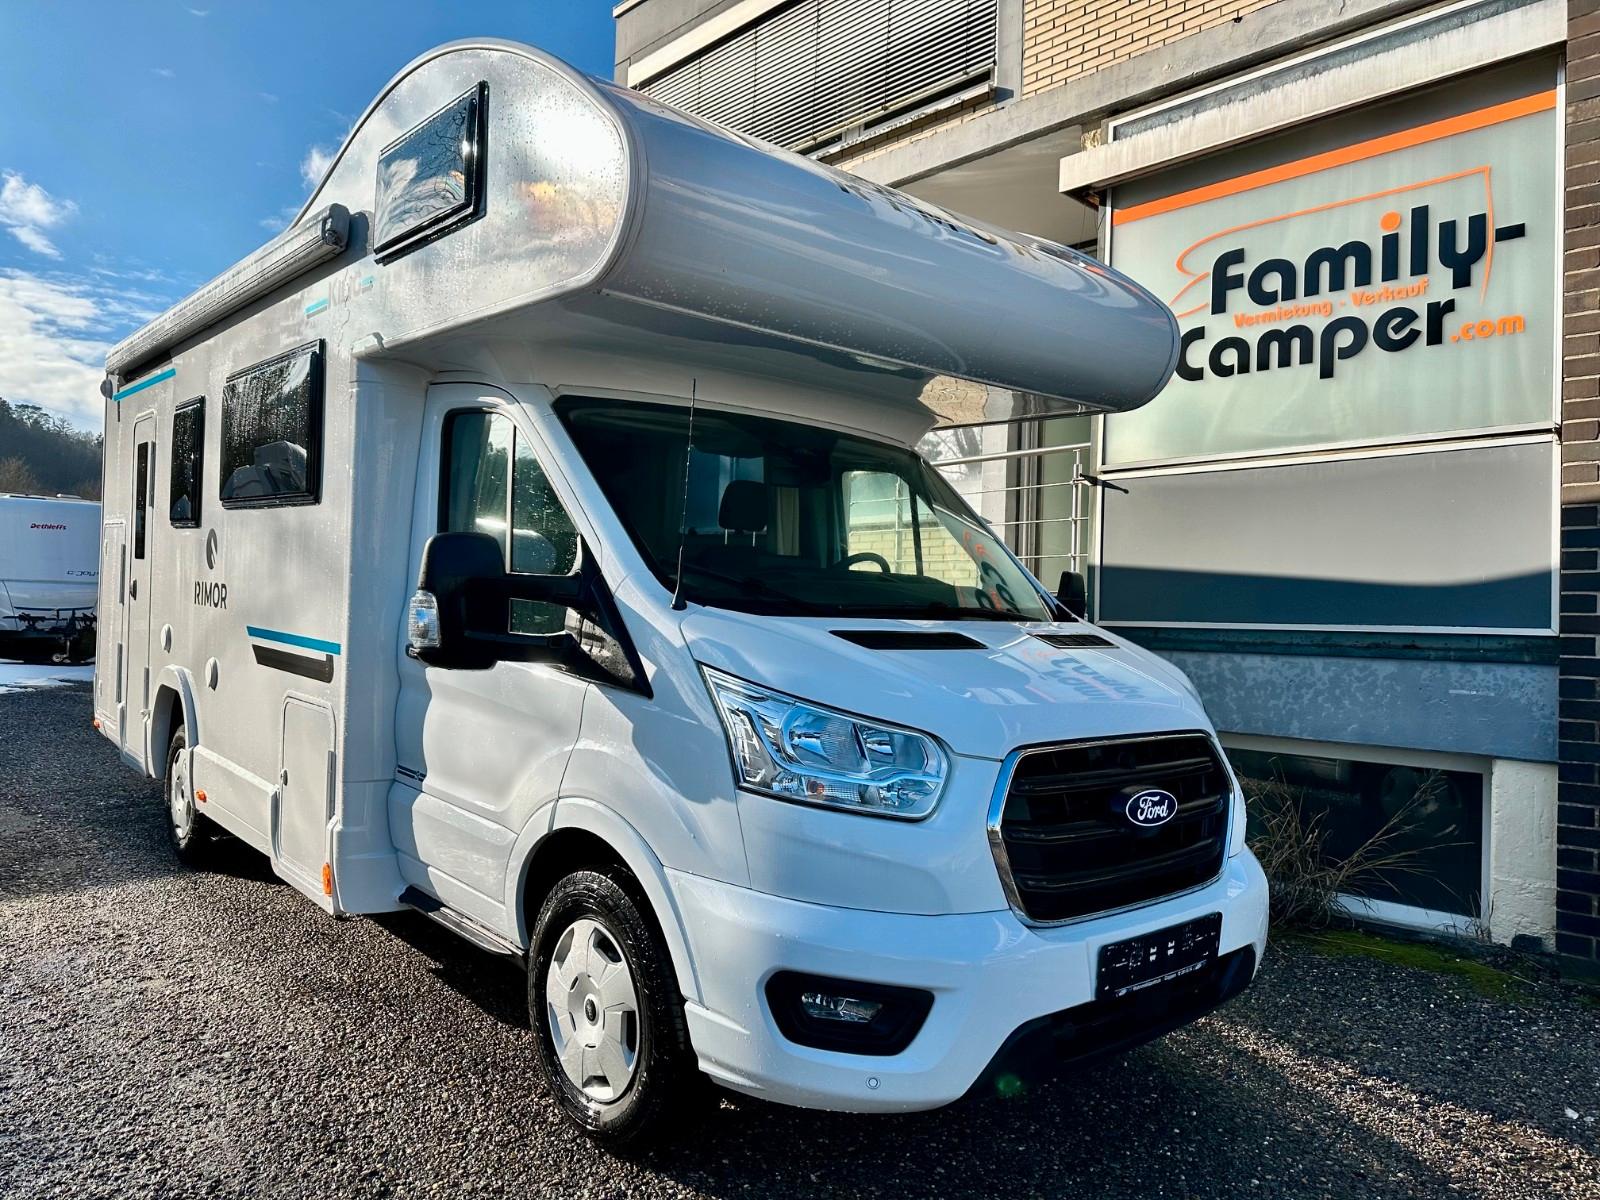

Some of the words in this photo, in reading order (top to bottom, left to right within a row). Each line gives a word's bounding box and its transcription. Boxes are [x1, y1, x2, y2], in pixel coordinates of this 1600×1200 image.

[1234, 301, 1332, 328] Vermietung
[1350, 278, 1429, 307] Verkauf
[30, 523, 67, 531] Dethleffs
[195, 581, 227, 609] RIMOR
[1137, 796, 1168, 820] Ford
